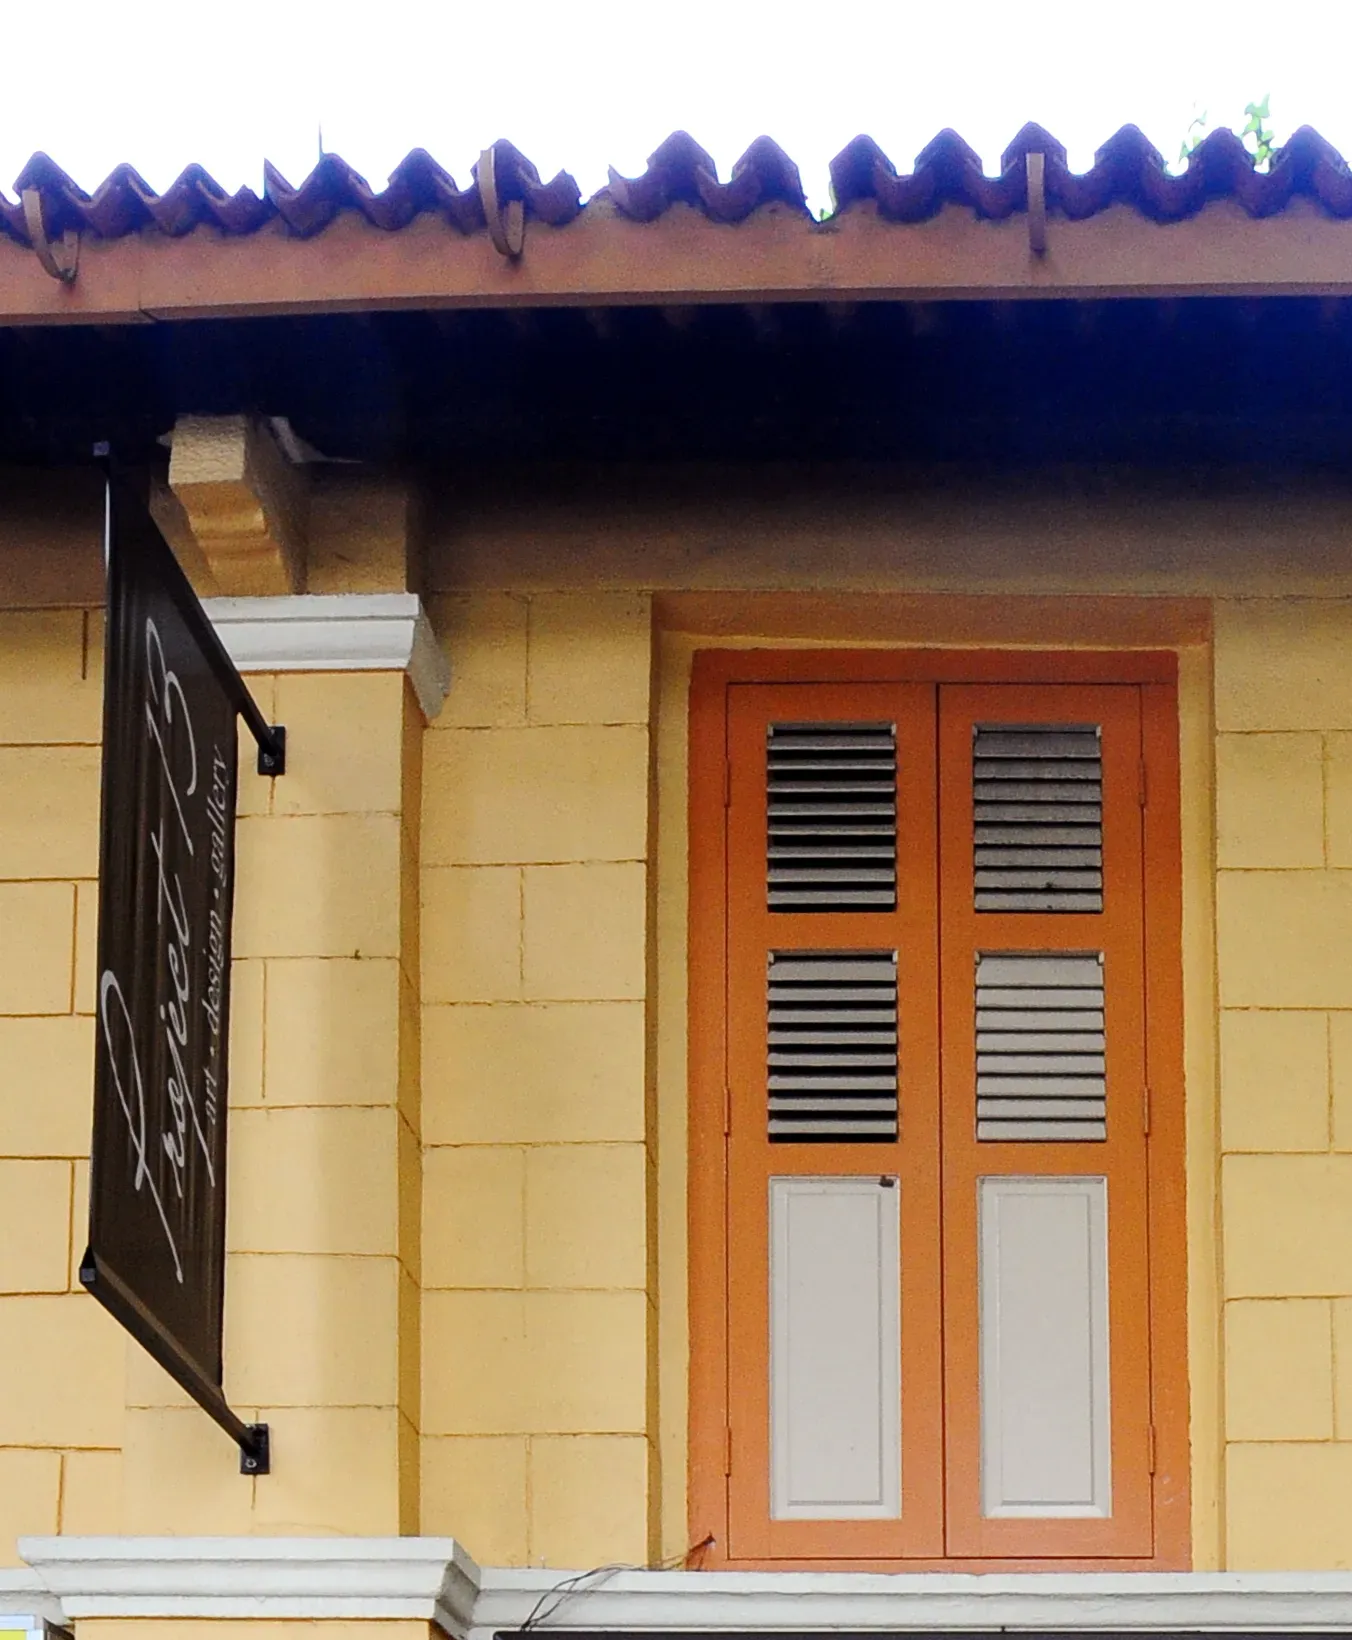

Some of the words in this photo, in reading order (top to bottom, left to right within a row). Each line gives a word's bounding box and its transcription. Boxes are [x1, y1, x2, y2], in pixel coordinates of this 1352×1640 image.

[146, 616, 198, 857] 13
[206, 743, 230, 890] gallery
[203, 913, 225, 1036] design
[101, 818, 216, 1284] Project
[204, 1066, 217, 1127] art
